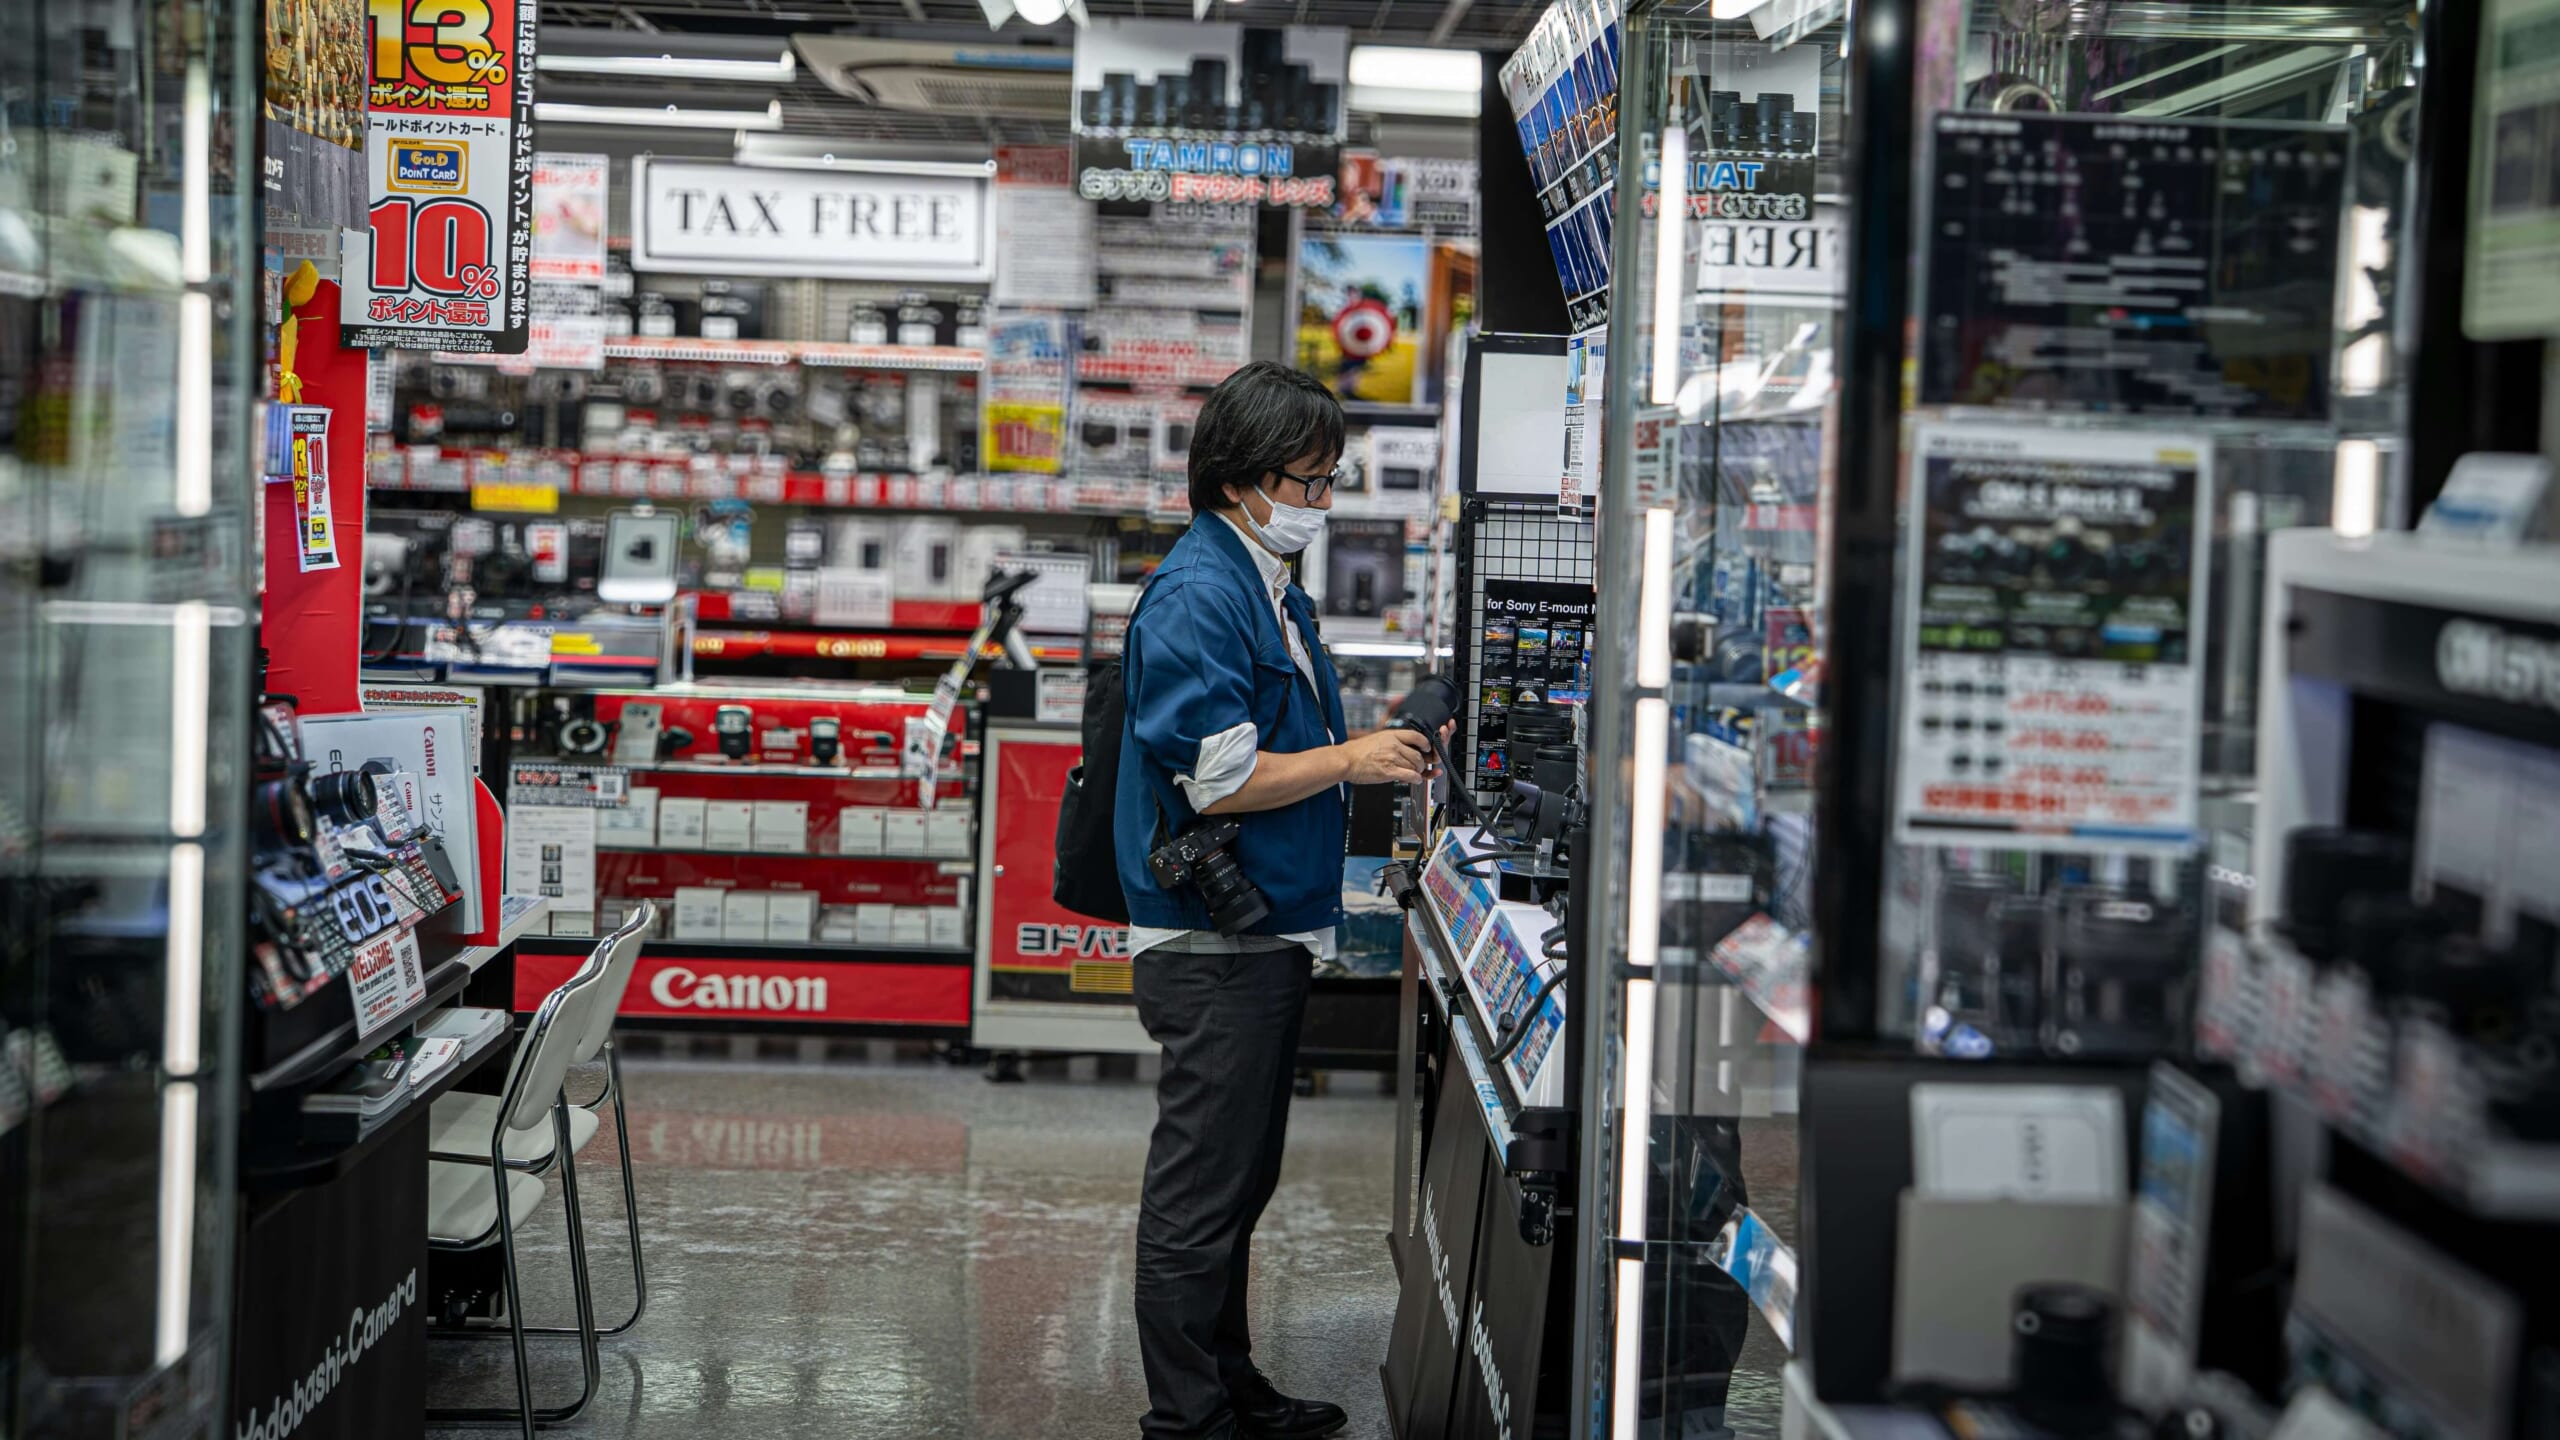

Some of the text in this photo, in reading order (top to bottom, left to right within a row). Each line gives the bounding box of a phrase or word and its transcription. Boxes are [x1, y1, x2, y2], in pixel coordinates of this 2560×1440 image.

[370, 84, 490, 110] ポイント還元
[411, 151, 449, 166] GOLD
[431, 168, 458, 180] CARD
[1127, 139, 1294, 176] TAMRON
[667, 188, 962, 245] TAX FREE
[369, 197, 501, 298] 10%
[369, 298, 490, 325] ポイント還元
[1487, 598, 1504, 610] for
[1506, 599, 1537, 614] Sony
[1539, 601, 1589, 614] E-mount
[424, 726, 436, 777] Canon
[405, 782, 413, 810] Canon
[333, 873, 398, 943] EOS
[351, 940, 396, 985] WELCOME!
[651, 967, 827, 1012] Canon
[237, 1268, 416, 1440] Yodobashi-Camera
